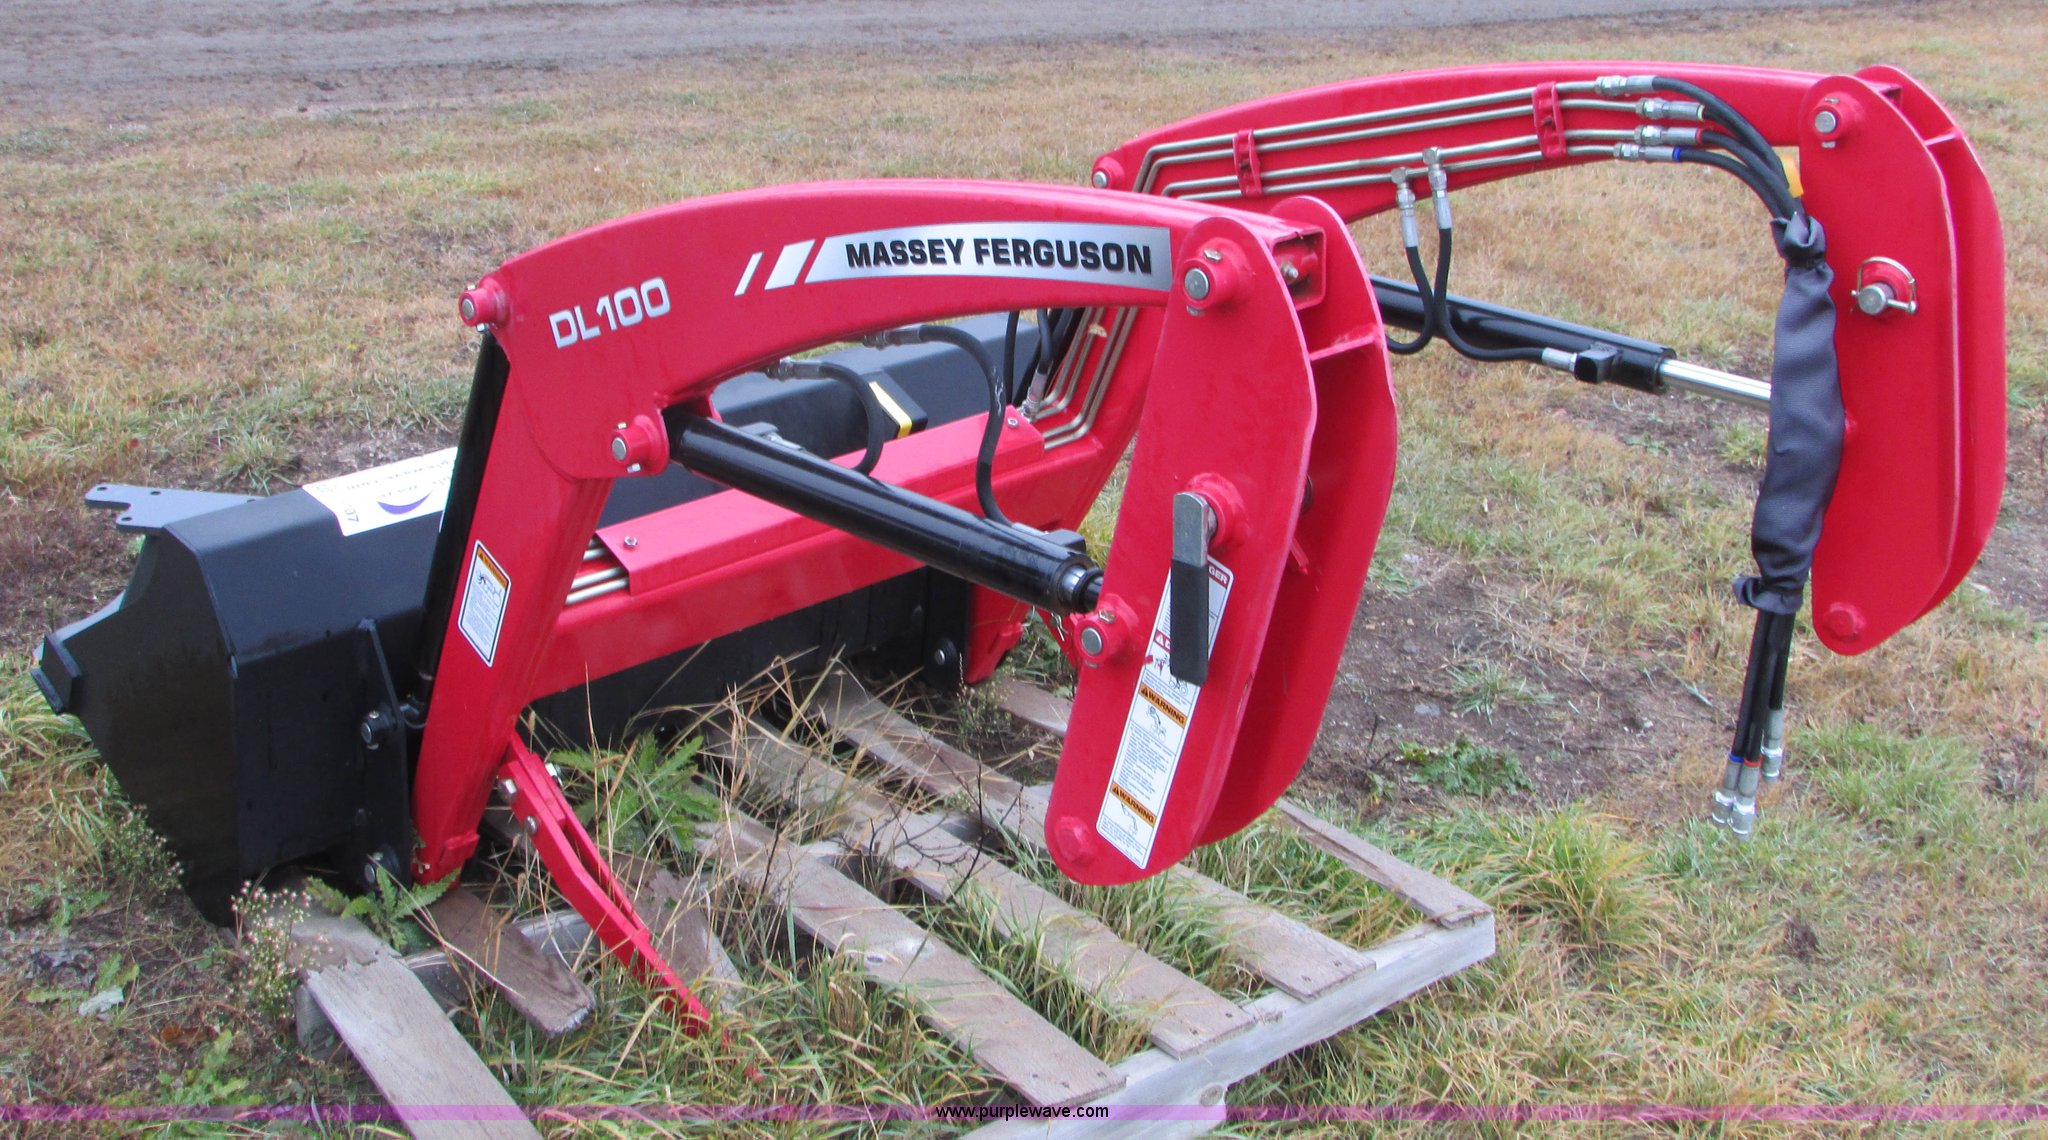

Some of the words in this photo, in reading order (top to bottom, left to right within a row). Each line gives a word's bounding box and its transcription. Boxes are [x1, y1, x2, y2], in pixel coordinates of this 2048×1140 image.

[845, 238, 964, 268] MASSEY
[973, 238, 1152, 274] FERGUSON
[548, 276, 671, 349] DL100
[1149, 689, 1185, 725] WARNING
[1119, 789, 1155, 824] WARNING
